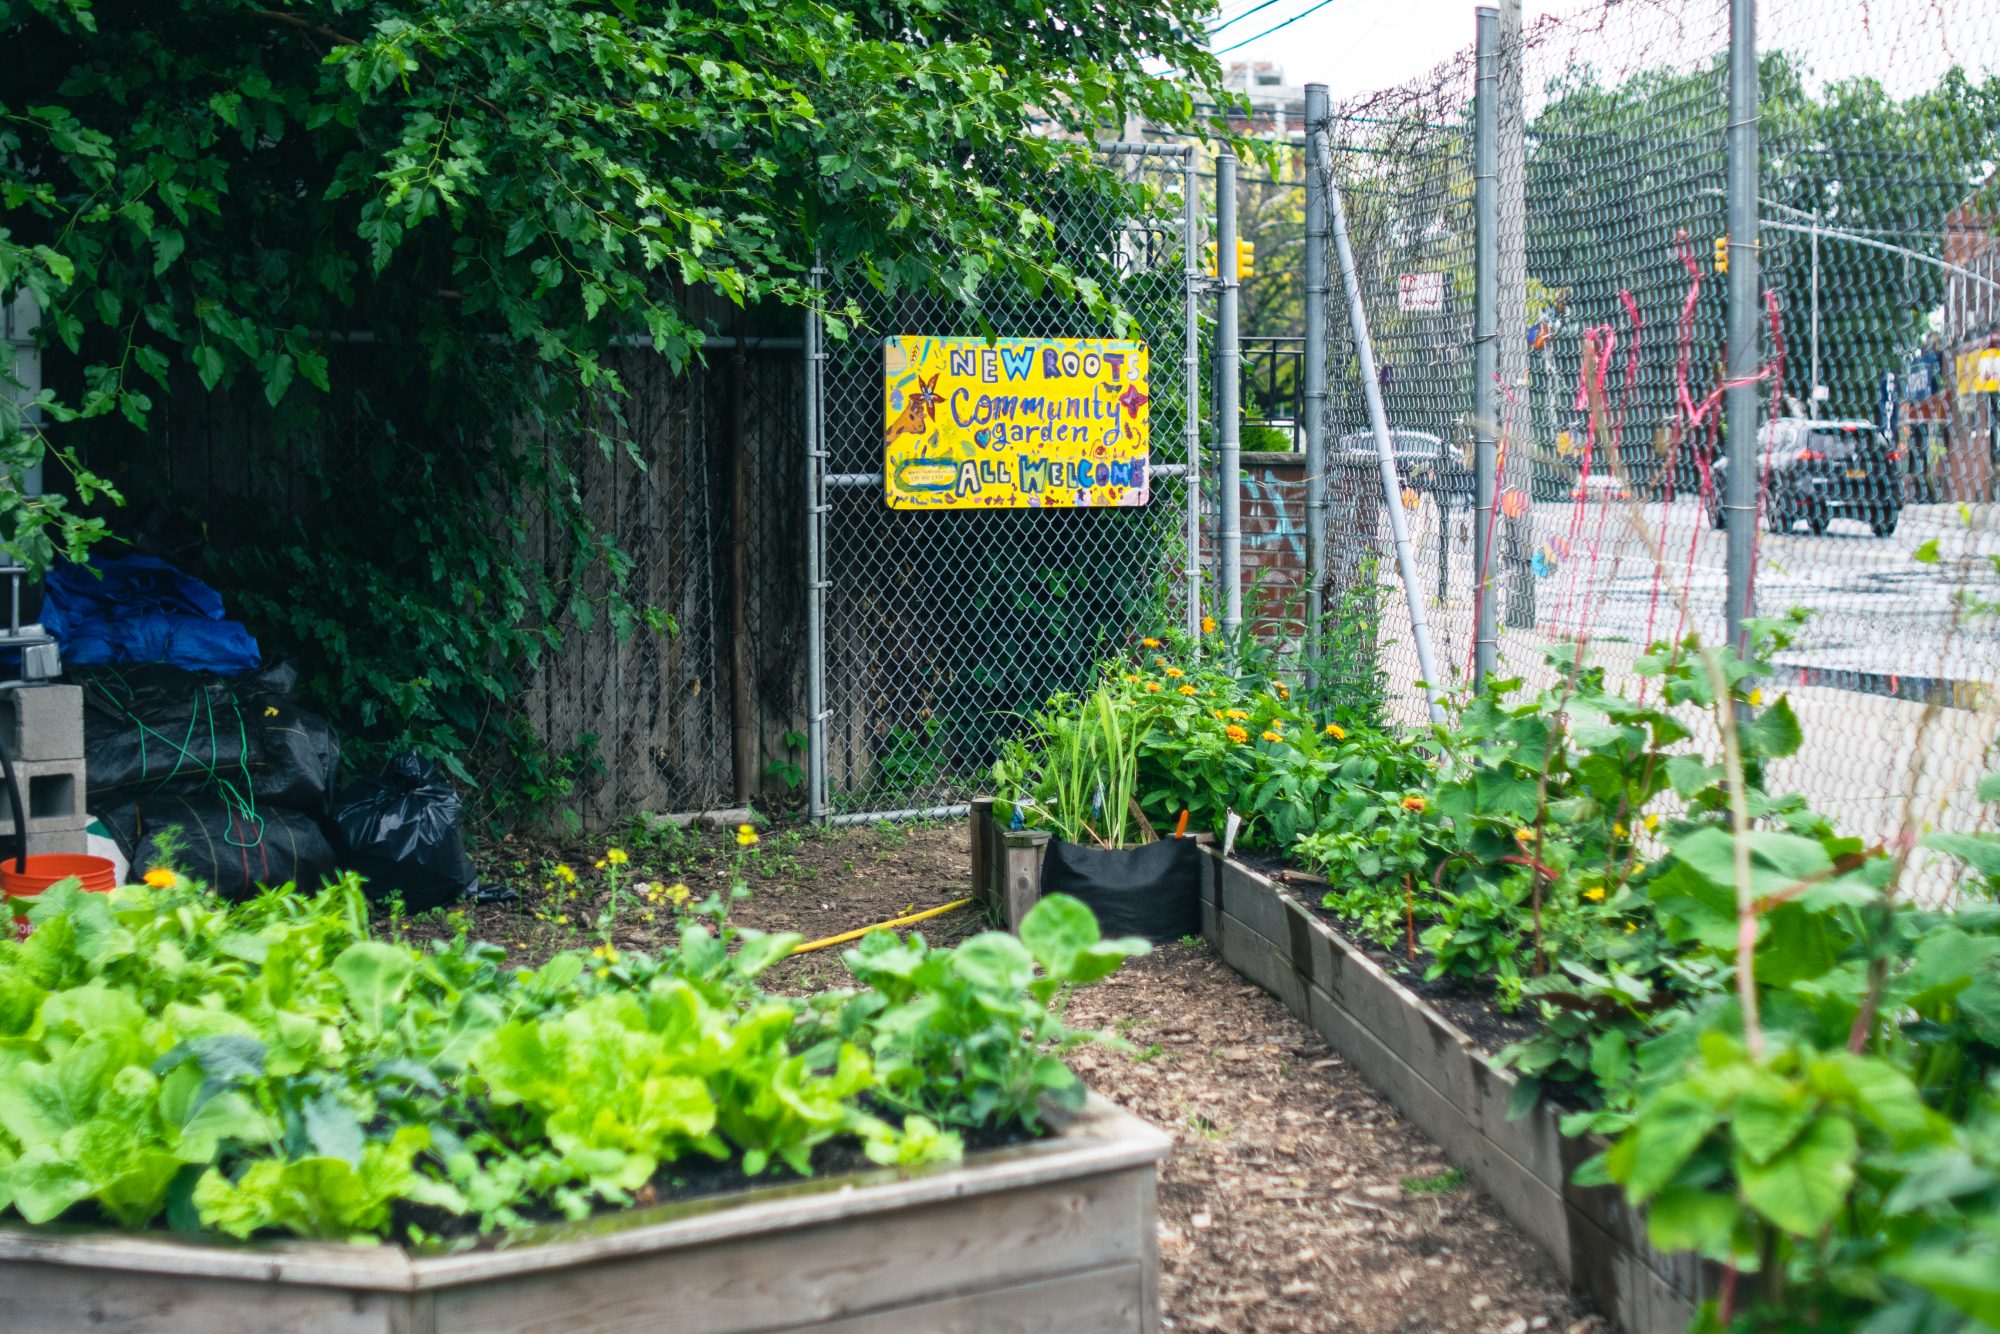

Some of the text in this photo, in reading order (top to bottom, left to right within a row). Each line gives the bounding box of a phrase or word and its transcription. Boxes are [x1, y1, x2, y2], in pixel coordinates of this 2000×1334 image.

[950, 346, 1140, 383] NEW ROOTS
[950, 385, 1124, 447] Community
[991, 420, 1089, 452] garden
[955, 454, 1146, 498] ALL WELCOME
